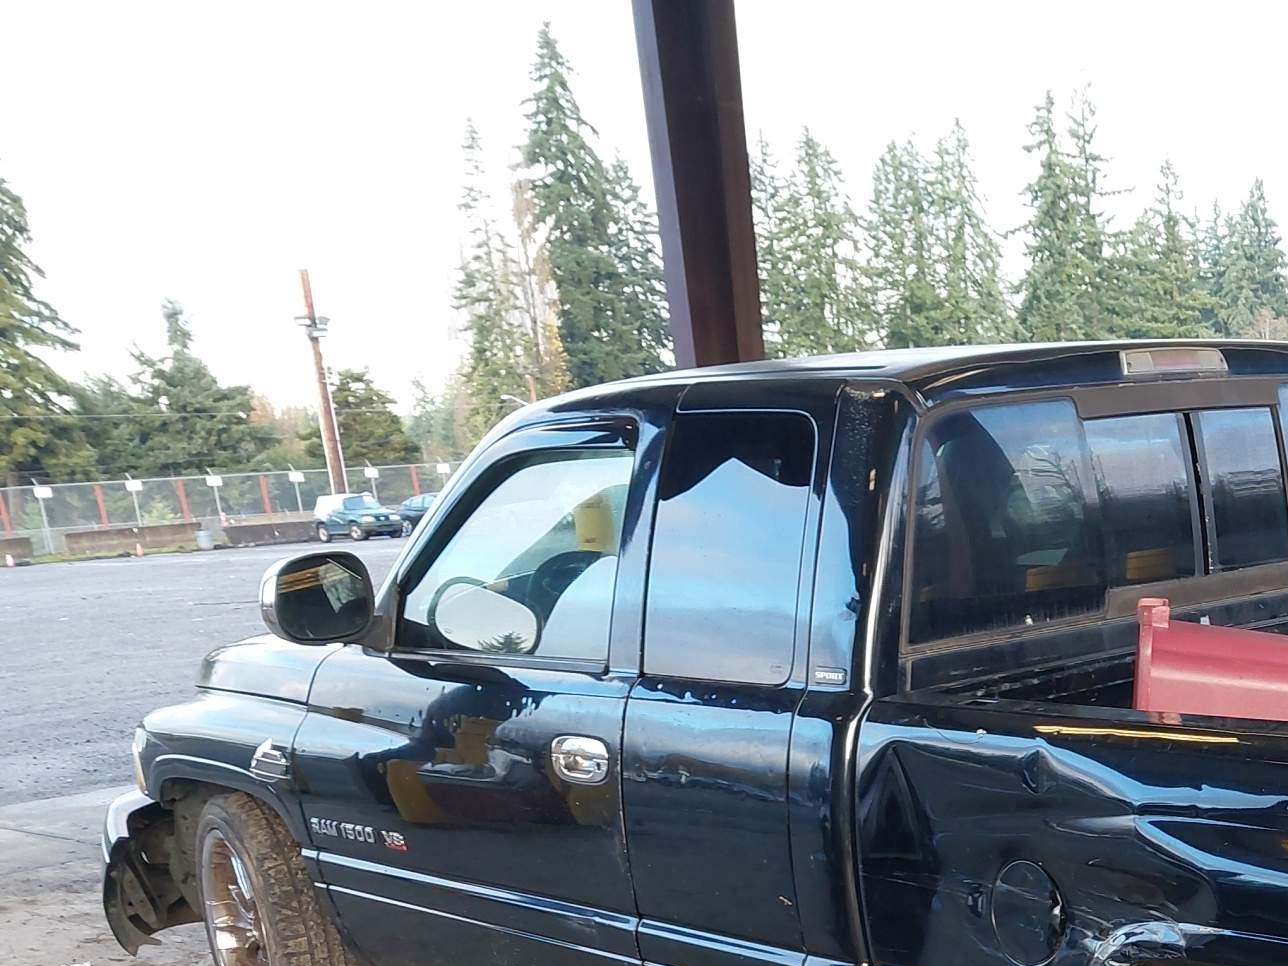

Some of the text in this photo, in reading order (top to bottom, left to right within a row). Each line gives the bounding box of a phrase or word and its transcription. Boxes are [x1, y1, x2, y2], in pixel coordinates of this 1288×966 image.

[310, 816, 406, 847] RAM 1500 V8
